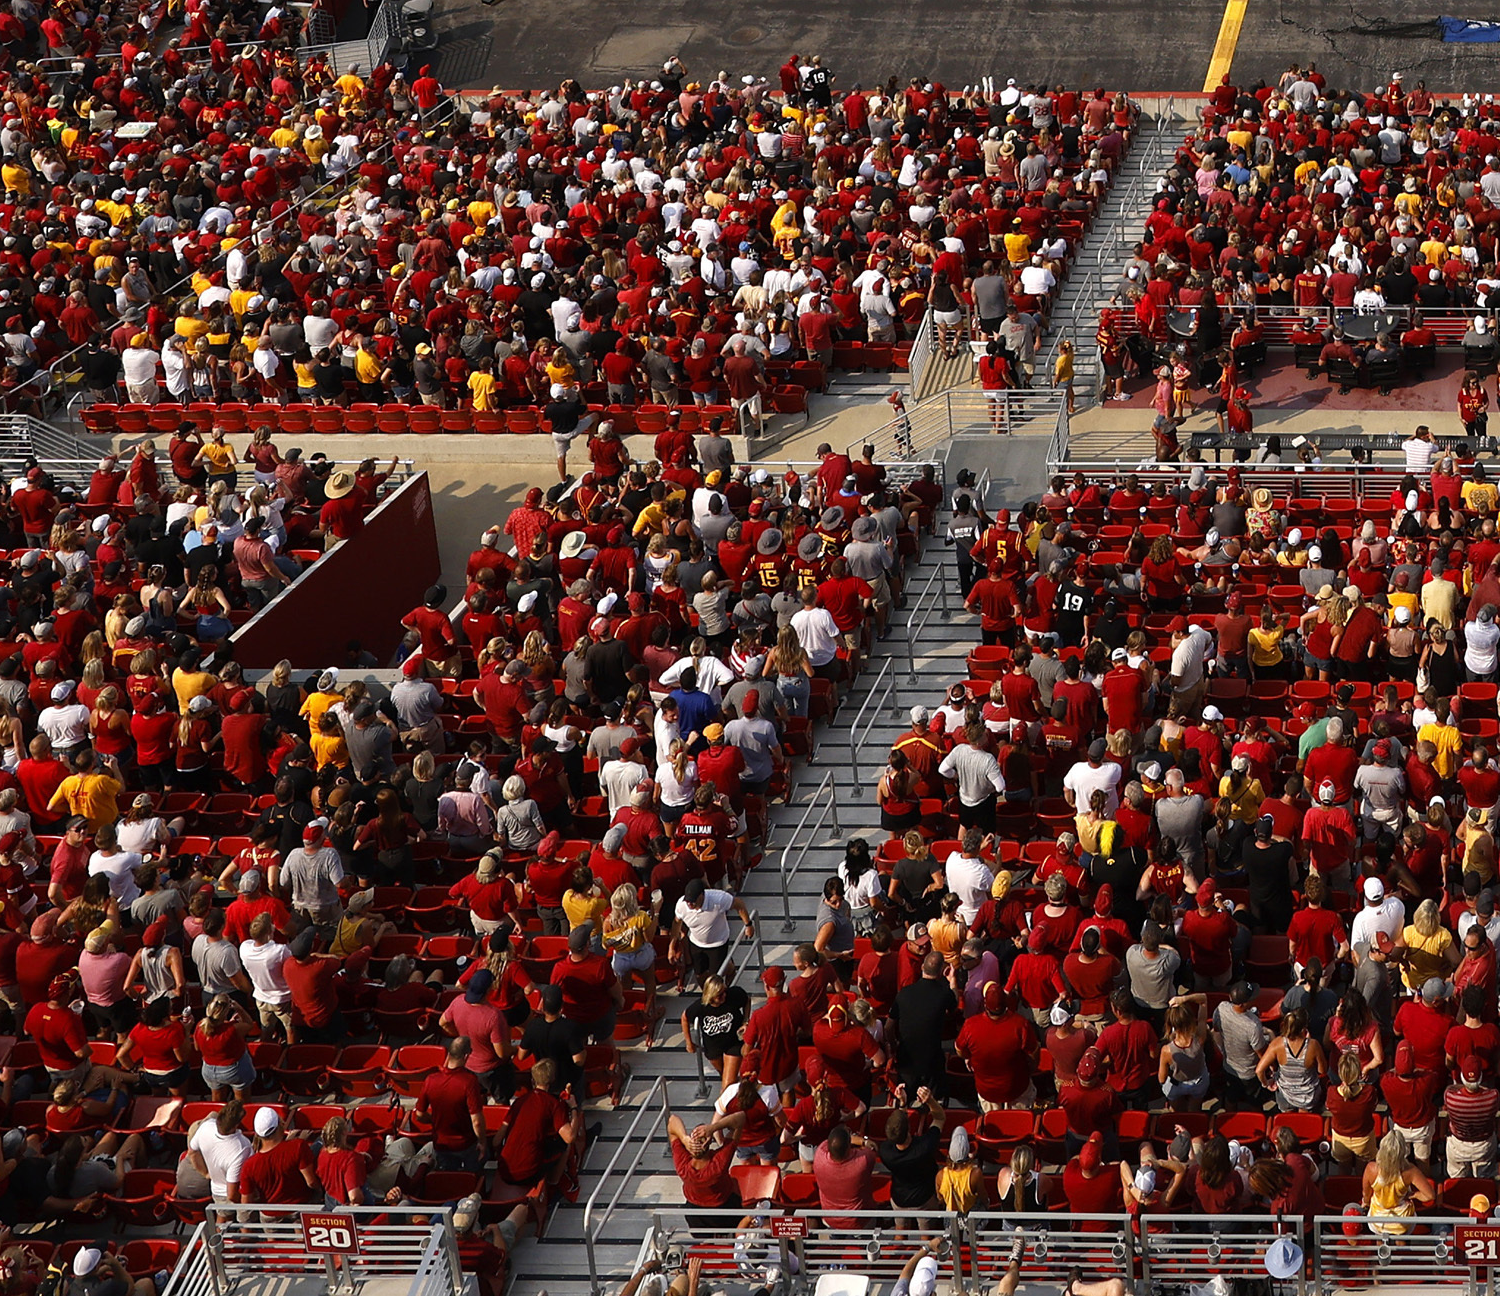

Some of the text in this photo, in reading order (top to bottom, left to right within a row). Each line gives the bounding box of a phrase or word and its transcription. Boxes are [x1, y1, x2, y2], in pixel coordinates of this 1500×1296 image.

[814, 73, 829, 86] 19
[1035, 106, 1049, 117] 28
[997, 540, 1007, 558] 5
[759, 561, 774, 569] PURDY
[758, 569, 779, 588] 15
[798, 568, 813, 576] PURDY
[1063, 591, 1083, 612] 19
[685, 824, 712, 835] TILLMAN
[685, 838, 717, 862] 42
[310, 1217, 346, 1226] SECTION
[308, 1226, 351, 1248] 20
[1463, 1230, 1500, 1238] SECTION
[1464, 1239, 1498, 1259] 21
